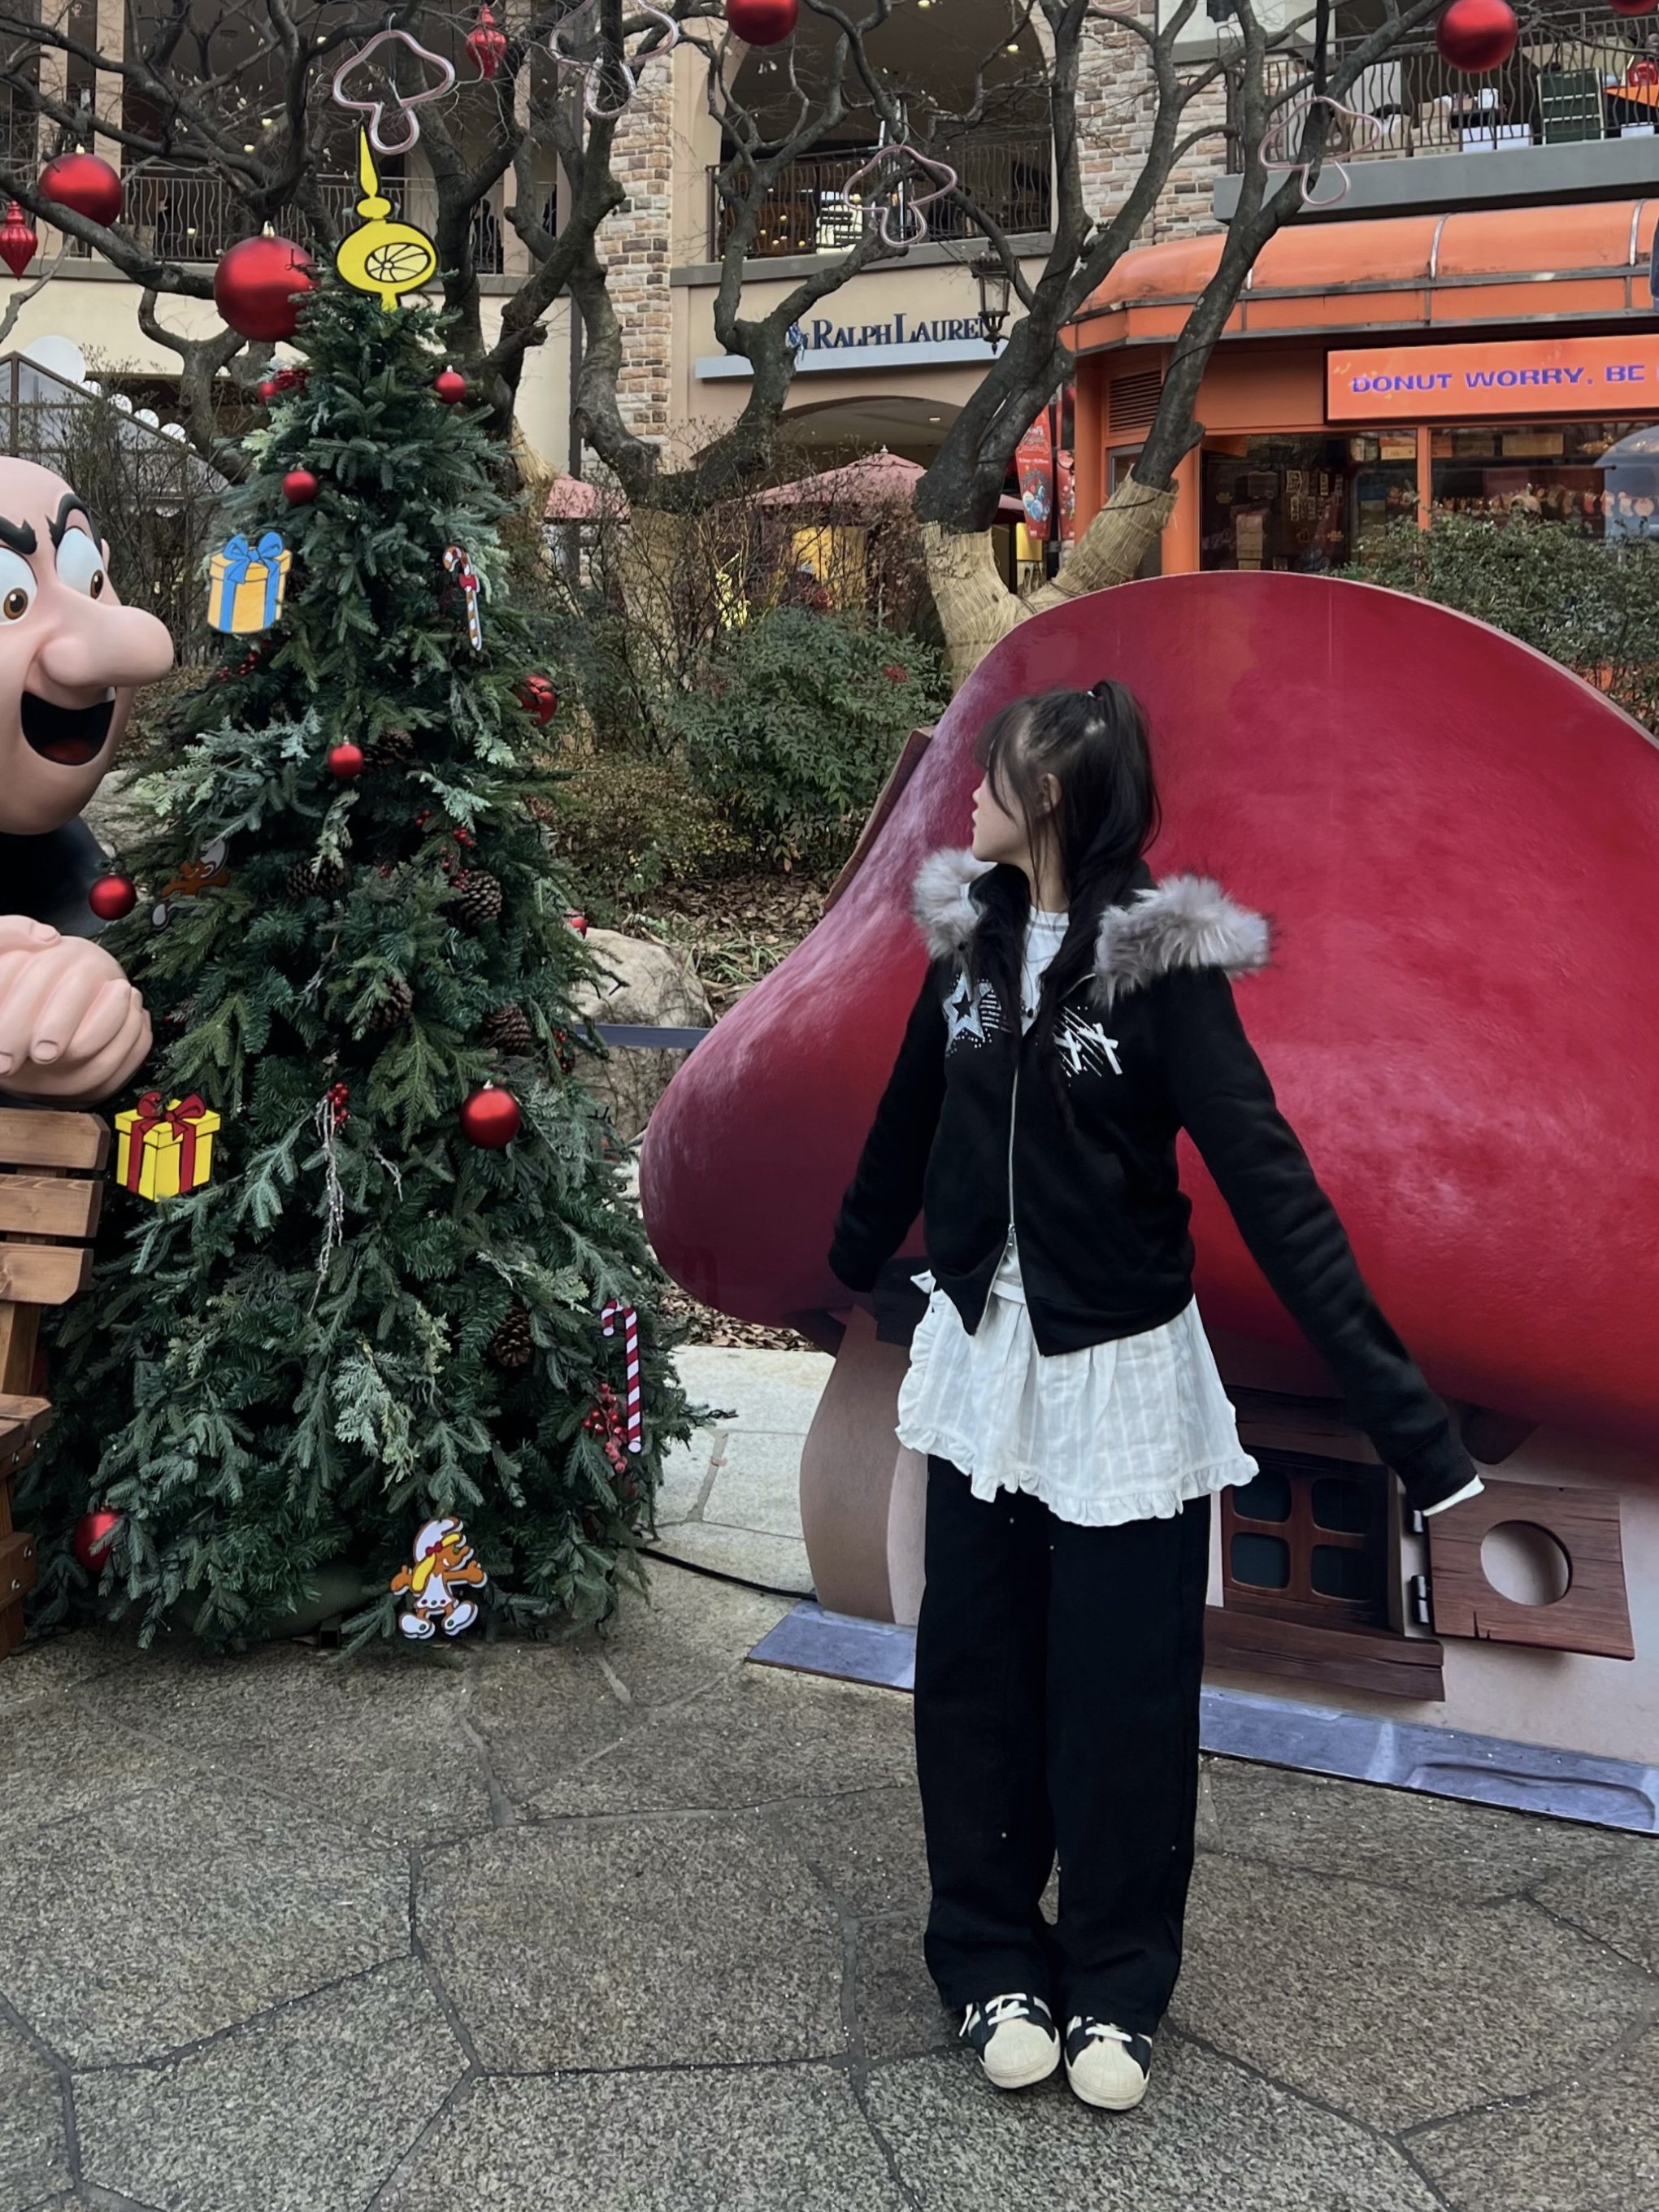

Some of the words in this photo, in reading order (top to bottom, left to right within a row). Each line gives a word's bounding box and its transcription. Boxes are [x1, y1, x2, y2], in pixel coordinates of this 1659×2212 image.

[811, 319, 892, 350] RALPH
[1353, 372, 1453, 393] DONUT
[1465, 366, 1593, 389] WORRY,
